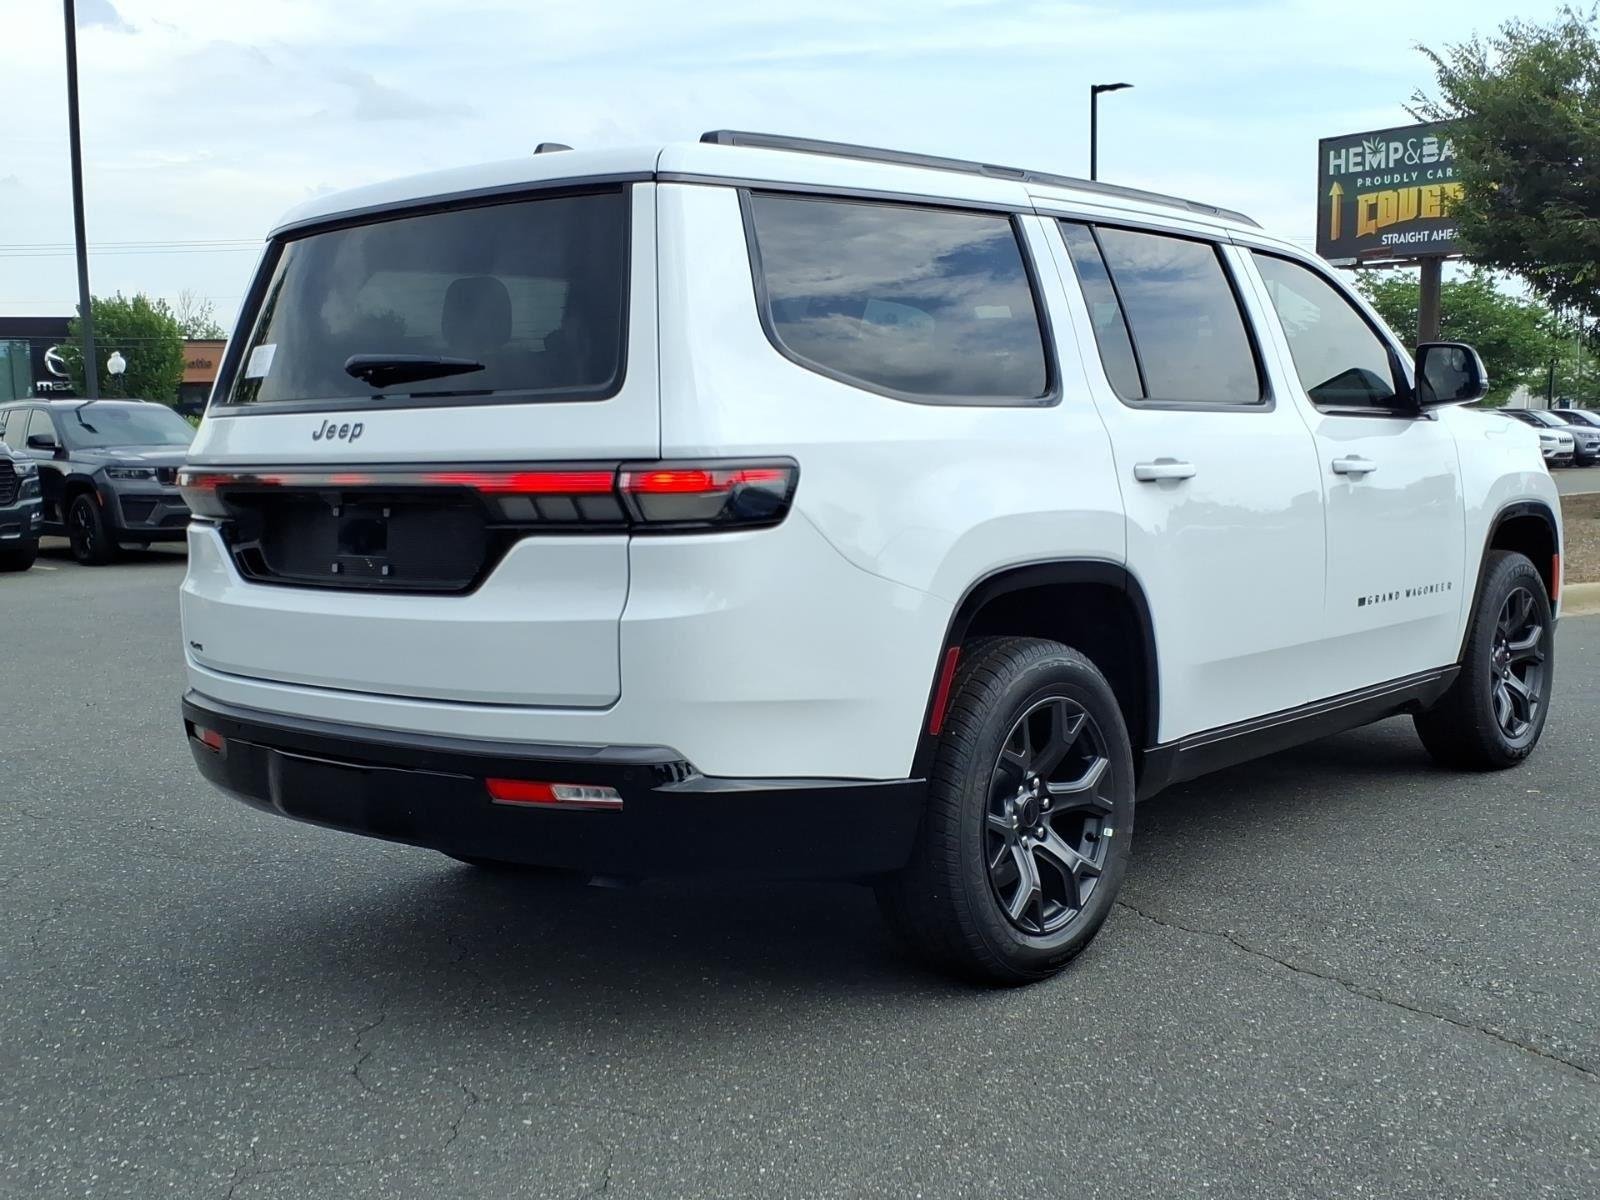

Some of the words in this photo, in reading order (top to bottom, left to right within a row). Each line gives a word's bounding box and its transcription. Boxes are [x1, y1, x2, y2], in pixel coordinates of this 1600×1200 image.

[1357, 172, 1418, 188] PROUDLY
[1381, 230, 1430, 246] STRAIGHT
[312, 419, 364, 443] Jeep
[1367, 591, 1400, 606] GRAND
[1405, 582, 1453, 599] WAGONEER
